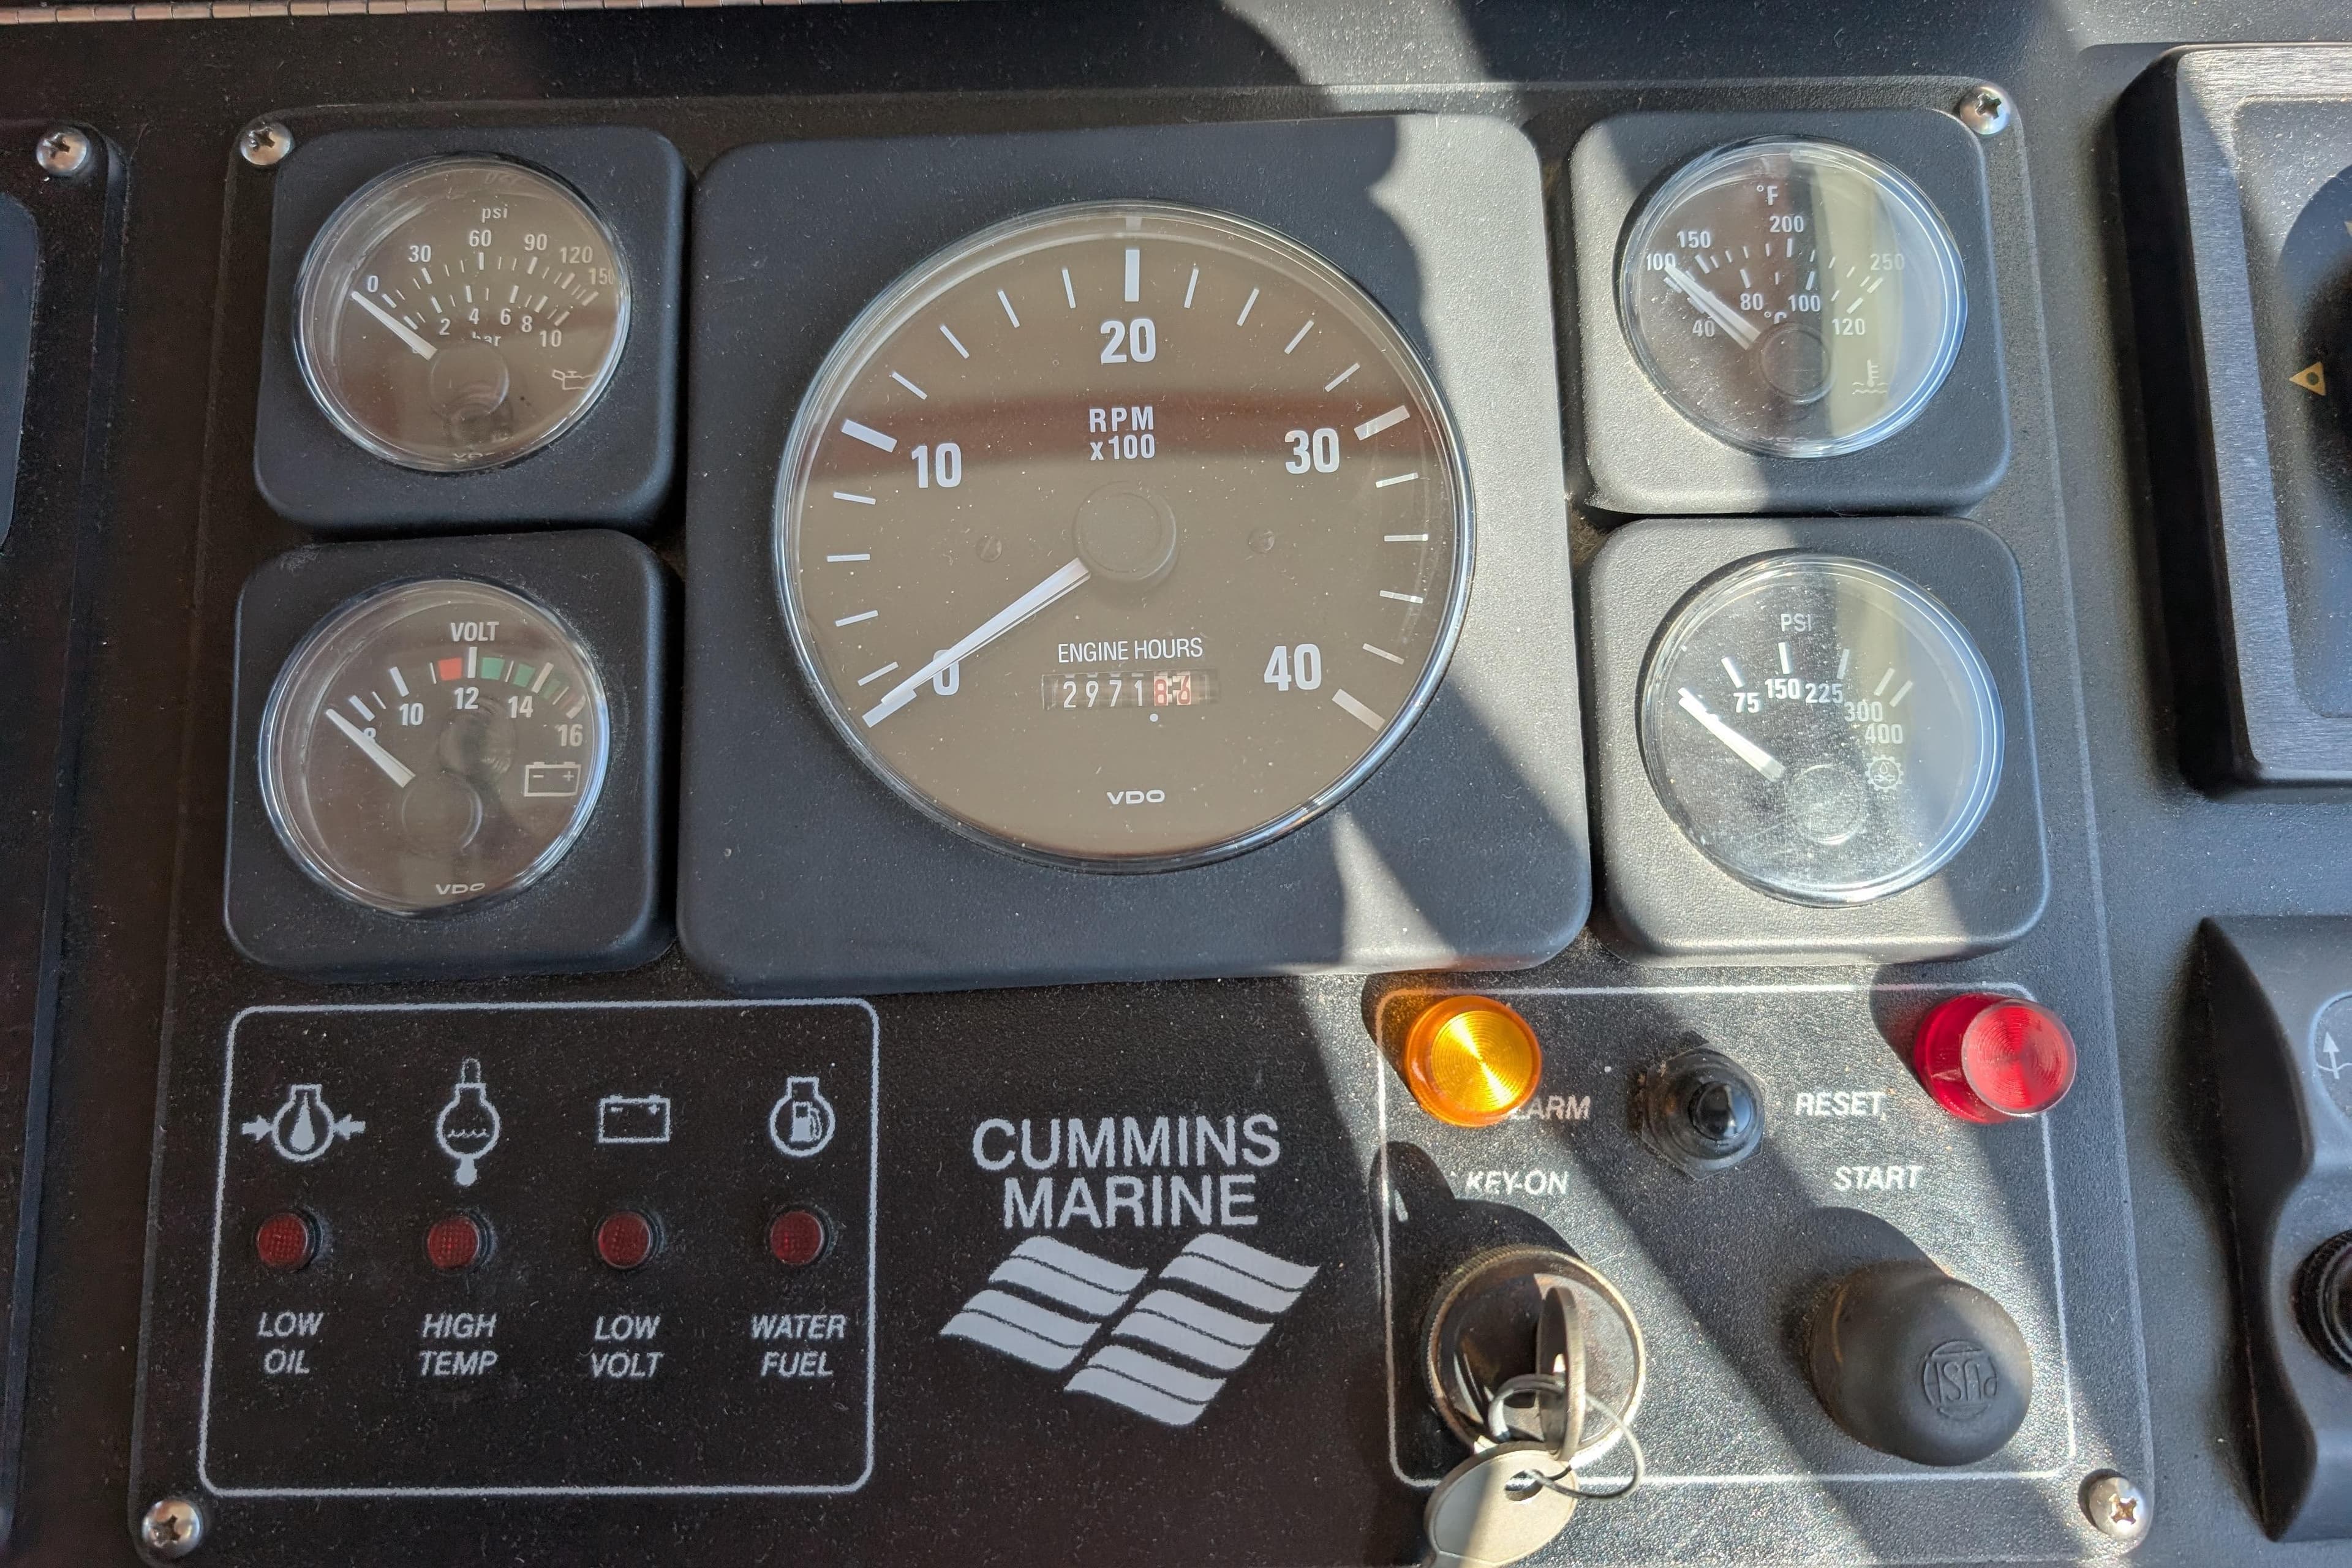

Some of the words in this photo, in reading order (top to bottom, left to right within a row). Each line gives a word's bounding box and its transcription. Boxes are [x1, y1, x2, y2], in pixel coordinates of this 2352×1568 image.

[481, 206, 507, 222] psi
[1769, 216, 1804, 232] 200
[469, 230, 491, 247] 60
[524, 233, 547, 251] 90
[1677, 230, 1711, 248] 150
[409, 246, 431, 263] 30
[560, 246, 593, 263] 120
[1869, 254, 1905, 271] 250
[367, 276, 378, 292] 0
[1740, 293, 1763, 311] 80
[1789, 295, 1820, 312] 100
[439, 318, 451, 335] 2
[469, 308, 480, 325] 4
[500, 308, 511, 325] 6
[521, 315, 532, 332] 8
[1832, 318, 1866, 336] 120
[1692, 319, 1715, 337] 40
[540, 331, 561, 347] 10
[1100, 318, 1156, 364] 20
[1089, 406, 1154, 432] RPM
[1090, 434, 1155, 461] x100
[1286, 428, 1340, 474] 30
[911, 443, 962, 488] 10
[451, 621, 499, 642] VOLT
[1781, 613, 1812, 632] PSI
[1058, 641, 1129, 663] ENGINE
[1134, 637, 1203, 660] HOURS
[1264, 643, 1322, 692] 40
[454, 687, 480, 709] 12
[1765, 678, 1800, 699] 150
[1805, 683, 1843, 703] 225
[508, 696, 533, 718] 14
[1733, 693, 1760, 713] 75
[1844, 701, 1883, 722] 300
[399, 703, 424, 725] 10
[558, 724, 582, 746] 16
[1865, 723, 1903, 744] 400
[1107, 790, 1165, 805] VDO
[435, 883, 485, 894] VDO
[1510, 1095, 1591, 1120] ARM
[1796, 1092, 1885, 1115] RESET
[972, 1113, 1281, 1170] CUMMINS
[1465, 1171, 1567, 1195] KEY-ON
[1833, 1165, 1923, 1191] START
[1003, 1174, 1259, 1229] MARINE
[257, 1312, 323, 1336] LOW
[423, 1313, 497, 1337] HIGH
[594, 1314, 661, 1340] LOW
[750, 1314, 847, 1339] WATER
[264, 1349, 310, 1374] OIL
[418, 1351, 499, 1376] TEMP
[590, 1352, 664, 1378] VOLT
[761, 1352, 834, 1377] FUEL
